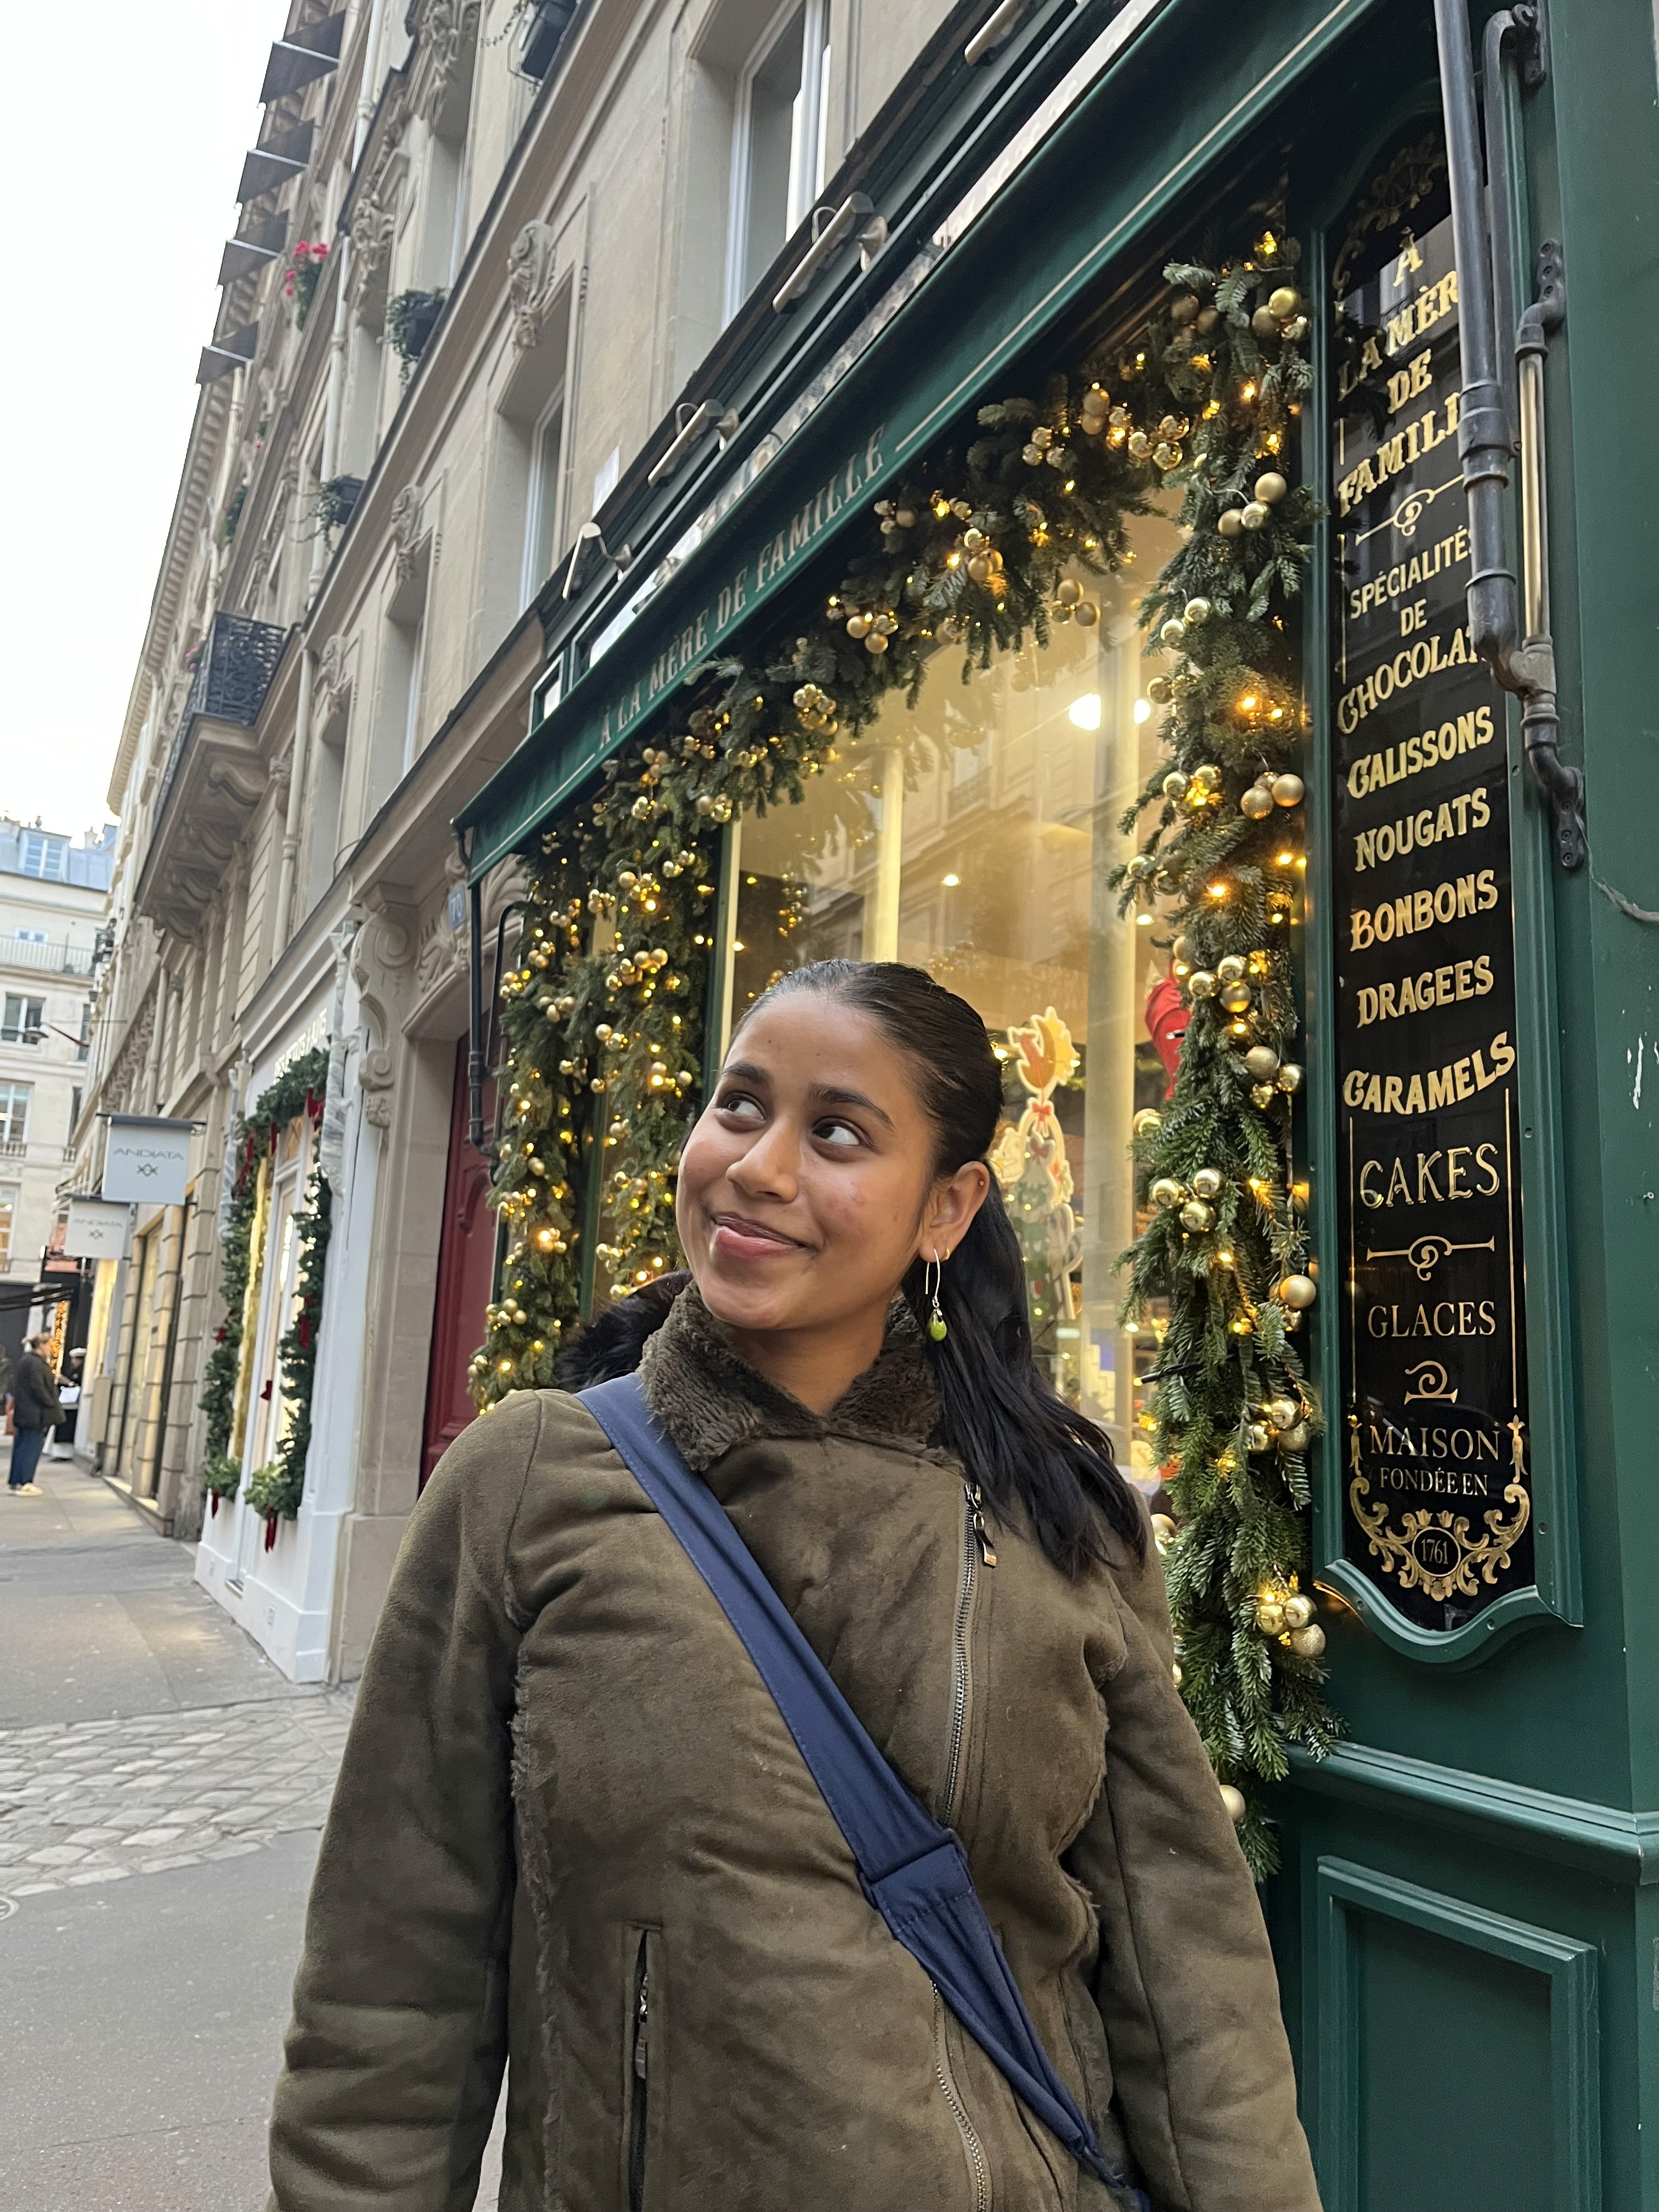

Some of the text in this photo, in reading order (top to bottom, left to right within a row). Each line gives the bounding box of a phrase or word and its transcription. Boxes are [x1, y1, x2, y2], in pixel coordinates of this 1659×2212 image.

[1338, 270, 1458, 402] LA MÈR
[1387, 348, 1432, 414] DE
[1338, 392, 1460, 517] FAMILL
[617, 680, 641, 732] LA
[647, 606, 709, 701] MÈRE
[715, 566, 748, 633] DE
[755, 423, 887, 592] FAMILLE
[1350, 524, 1472, 619] SPÉCIALITÉ
[1400, 598, 1427, 637] DE
[1337, 625, 1487, 735] CHOCOLA
[1346, 706, 1494, 799] CALISSONS
[1353, 787, 1491, 872] NOUGATS
[1350, 869, 1498, 952] BONBONS
[1356, 955, 1494, 1029] DRAGEES
[1342, 1031, 1515, 1115] CARAMELS
[1359, 1143, 1500, 1209] CAKES
[1368, 1300, 1496, 1338] GLACES
[1370, 1425, 1500, 1461] MAISON
[1380, 1466, 1488, 1496] FONDÉE EN
[1421, 1538, 1449, 1565] 1761
